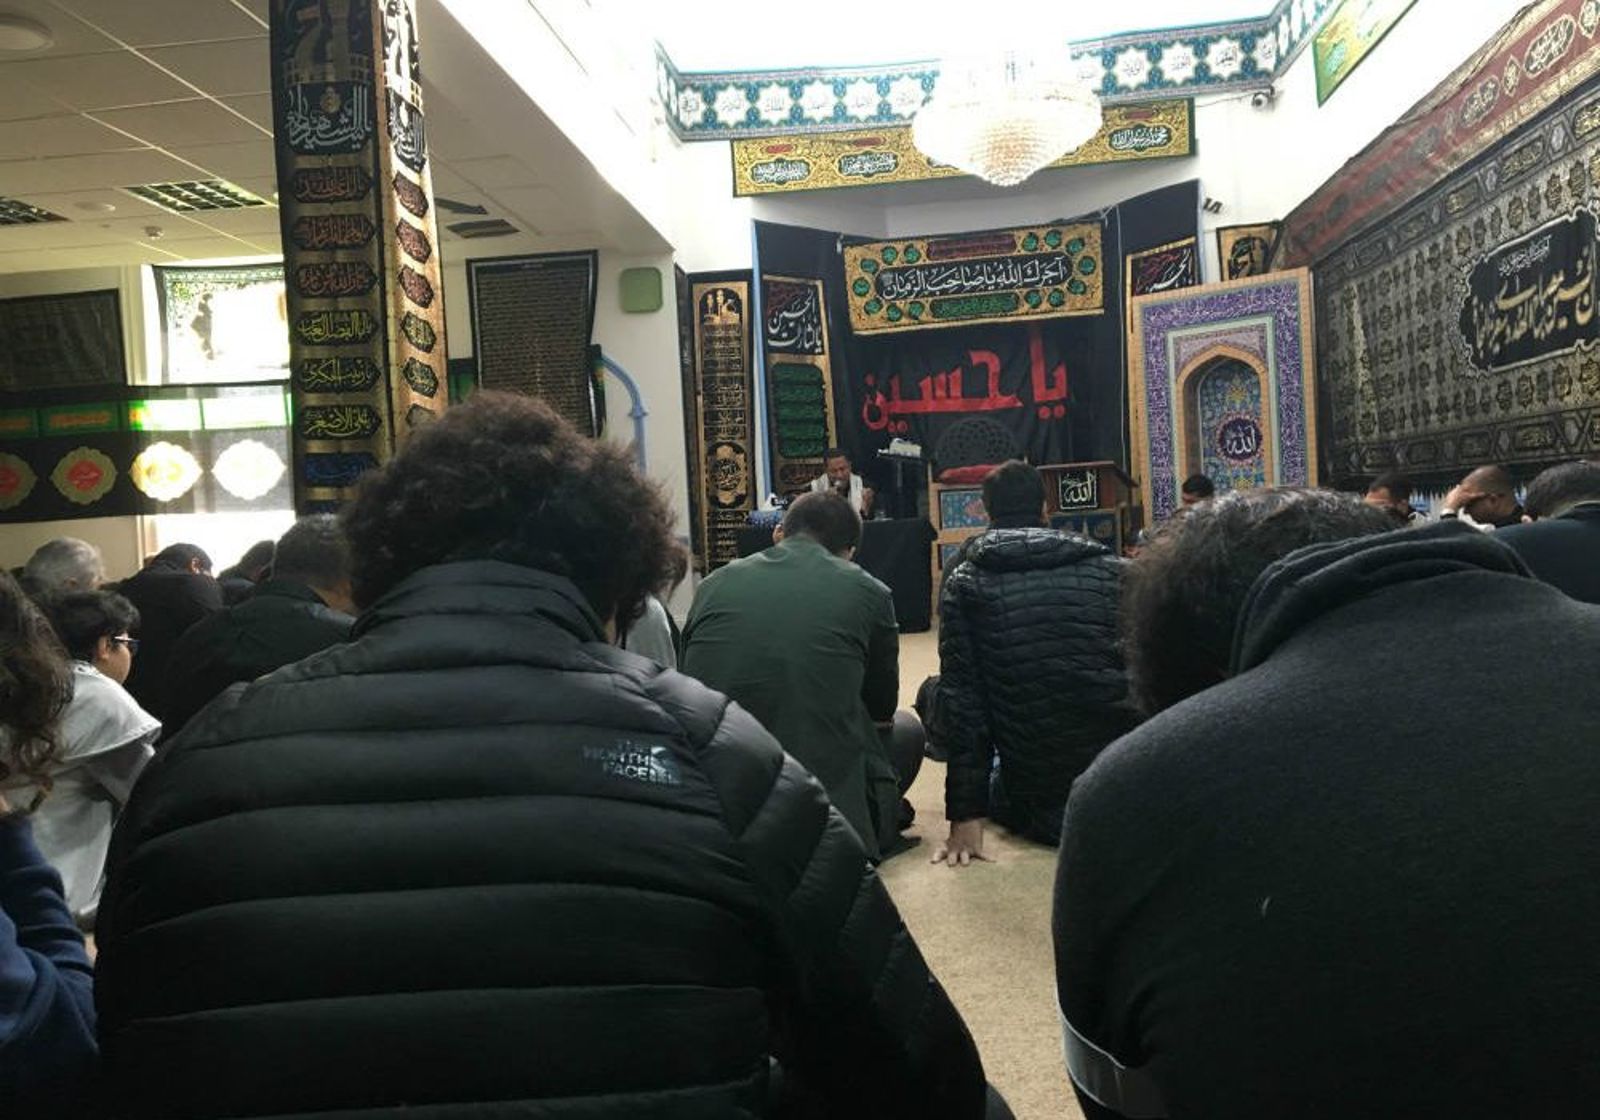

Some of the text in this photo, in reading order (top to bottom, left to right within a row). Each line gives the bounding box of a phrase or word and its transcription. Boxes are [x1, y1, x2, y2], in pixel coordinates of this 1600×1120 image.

[882, 267, 926, 300] الزمان
[926, 264, 983, 296] صاحب
[983, 264, 996, 290] يا
[996, 260, 1023, 287] الله
[862, 349, 1024, 433] حسين
[1030, 334, 1068, 420] يا
[1225, 425, 1257, 455] الله
[1063, 472, 1094, 503] الله
